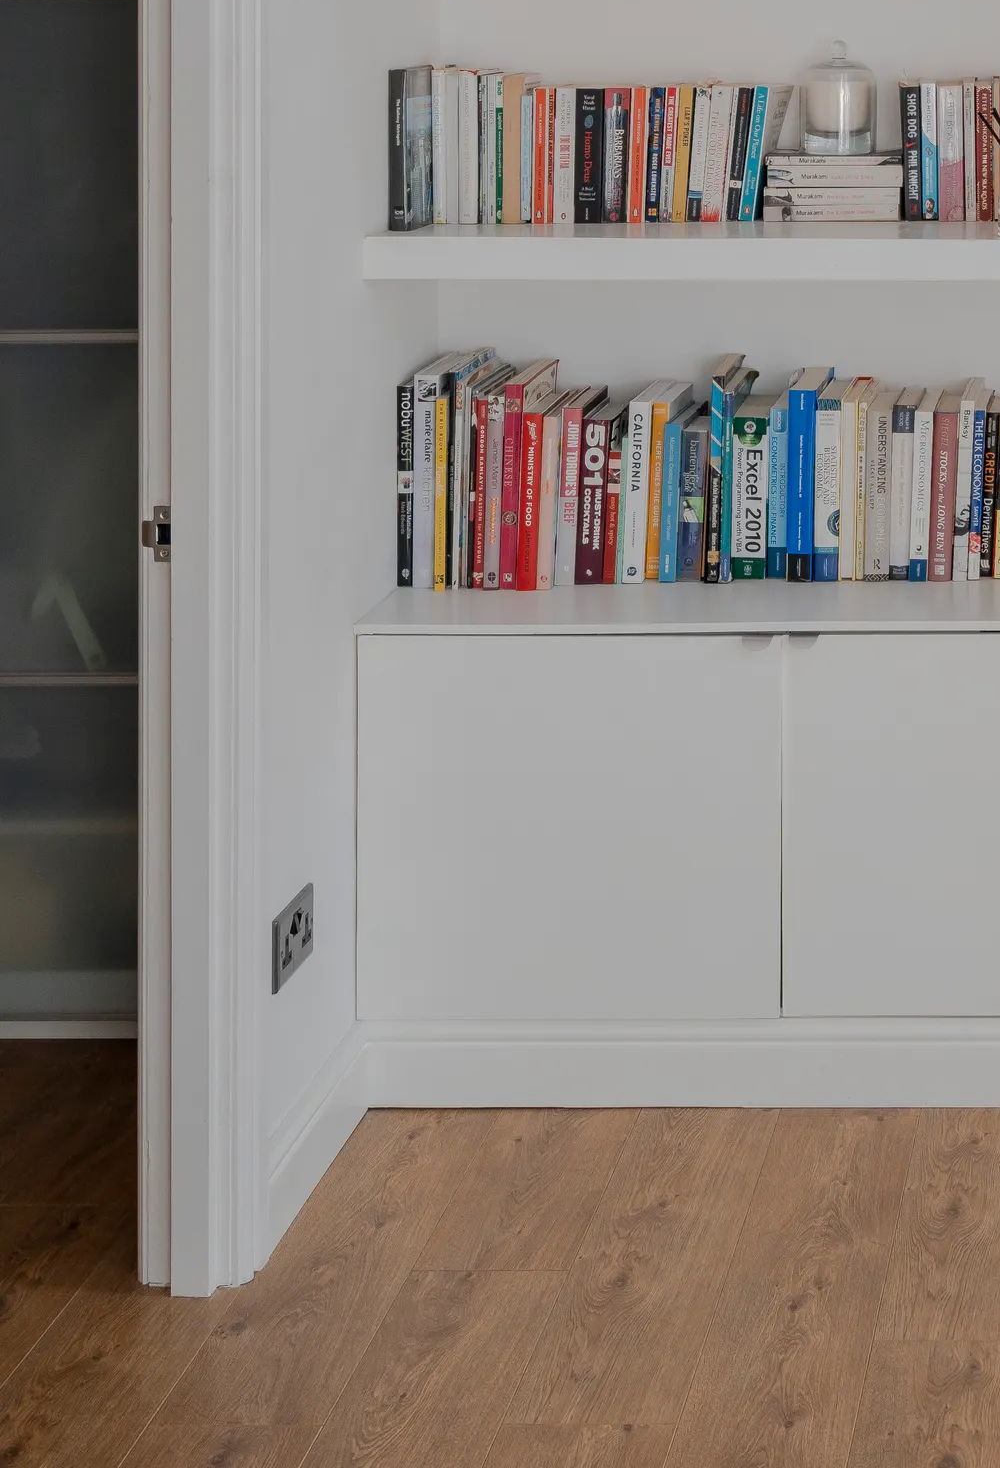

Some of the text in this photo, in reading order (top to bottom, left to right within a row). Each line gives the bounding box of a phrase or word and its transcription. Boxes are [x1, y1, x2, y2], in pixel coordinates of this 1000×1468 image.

[756, 115, 761, 123] on
[907, 94, 917, 138] SHOE DOG
[584, 131, 592, 182] Homo Deus
[908, 150, 918, 200] PHIL KNIGHT
[400, 392, 413, 463] nobu WEST
[424, 411, 433, 462] marie claire
[962, 410, 971, 439] Banksy
[975, 438, 983, 452] UK
[504, 438, 513, 487] CHINESE
[565, 421, 579, 496] JOHN TORODE'S
[584, 424, 605, 486] 501
[631, 414, 643, 492] CALIFORNIA
[688, 440, 699, 492] bartender's
[877, 417, 887, 494] UNDERSTANDING
[917, 420, 930, 512] MICROECONOMICS
[939, 451, 948, 482] STOCKS
[973, 454, 982, 501] ECONOMY
[525, 447, 534, 527] MINISTRY OF FOOD
[683, 472, 692, 492] guide
[735, 472, 743, 518] Programming
[745, 449, 763, 552] Excel 2010
[938, 483, 946, 493] for
[981, 452, 995, 553] CREDIT Derivatives
[582, 489, 591, 544] COCKTAILS
[592, 489, 601, 550] MUST-DRINK
[607, 530, 615, 545] spicy
[936, 532, 945, 550] RUN
[937, 505, 946, 529] LONG
